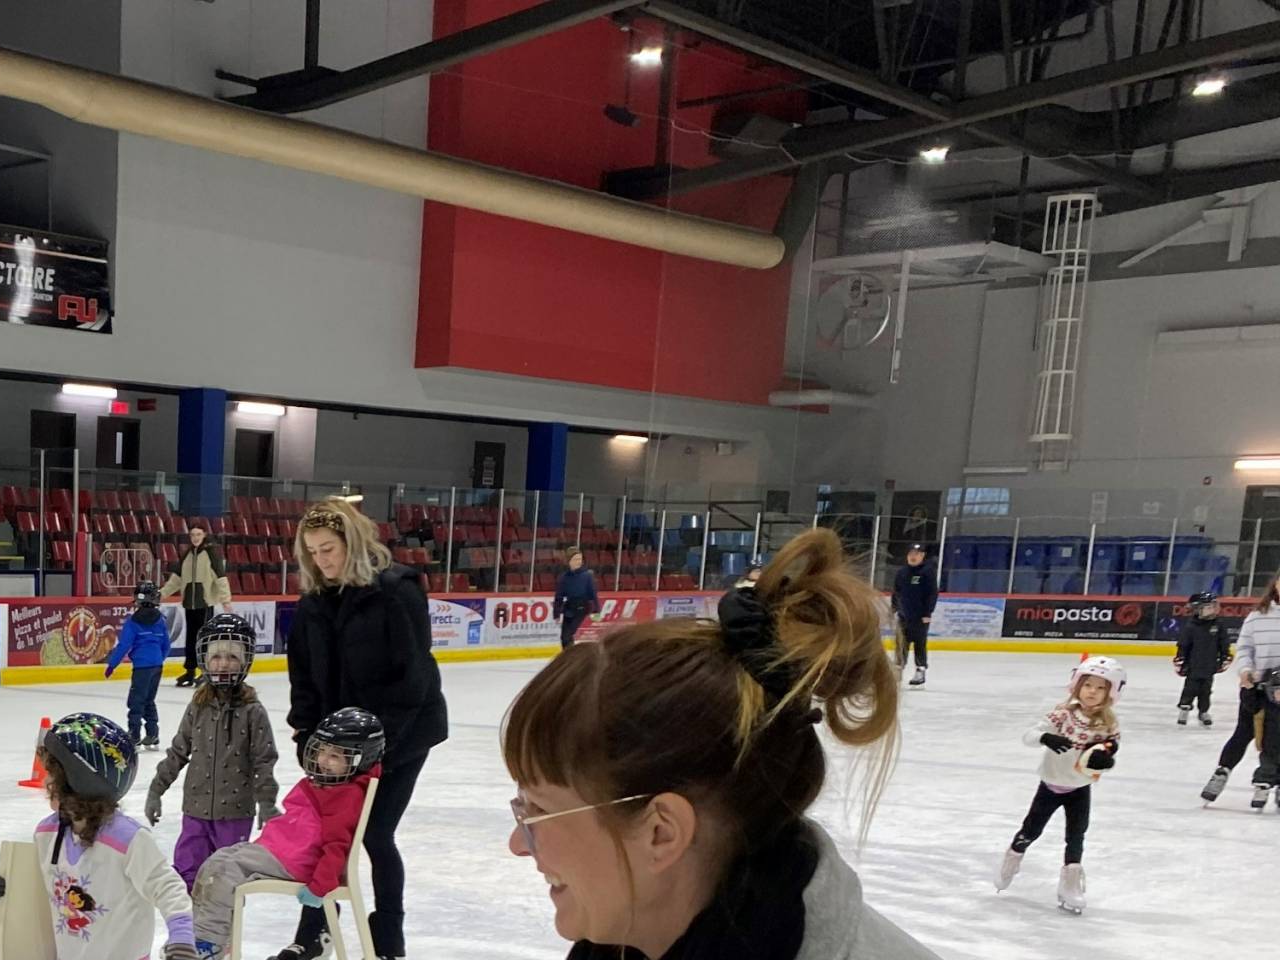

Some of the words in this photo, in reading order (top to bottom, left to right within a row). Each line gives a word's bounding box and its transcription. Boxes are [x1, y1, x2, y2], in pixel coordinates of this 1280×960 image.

[12, 607, 42, 623] Meilleurs
[33, 618, 41, 630] et
[43, 610, 63, 632] poulet
[1017, 606, 1112, 624] miapasta
[17, 637, 25, 650] de
[26, 634, 34, 646] la
